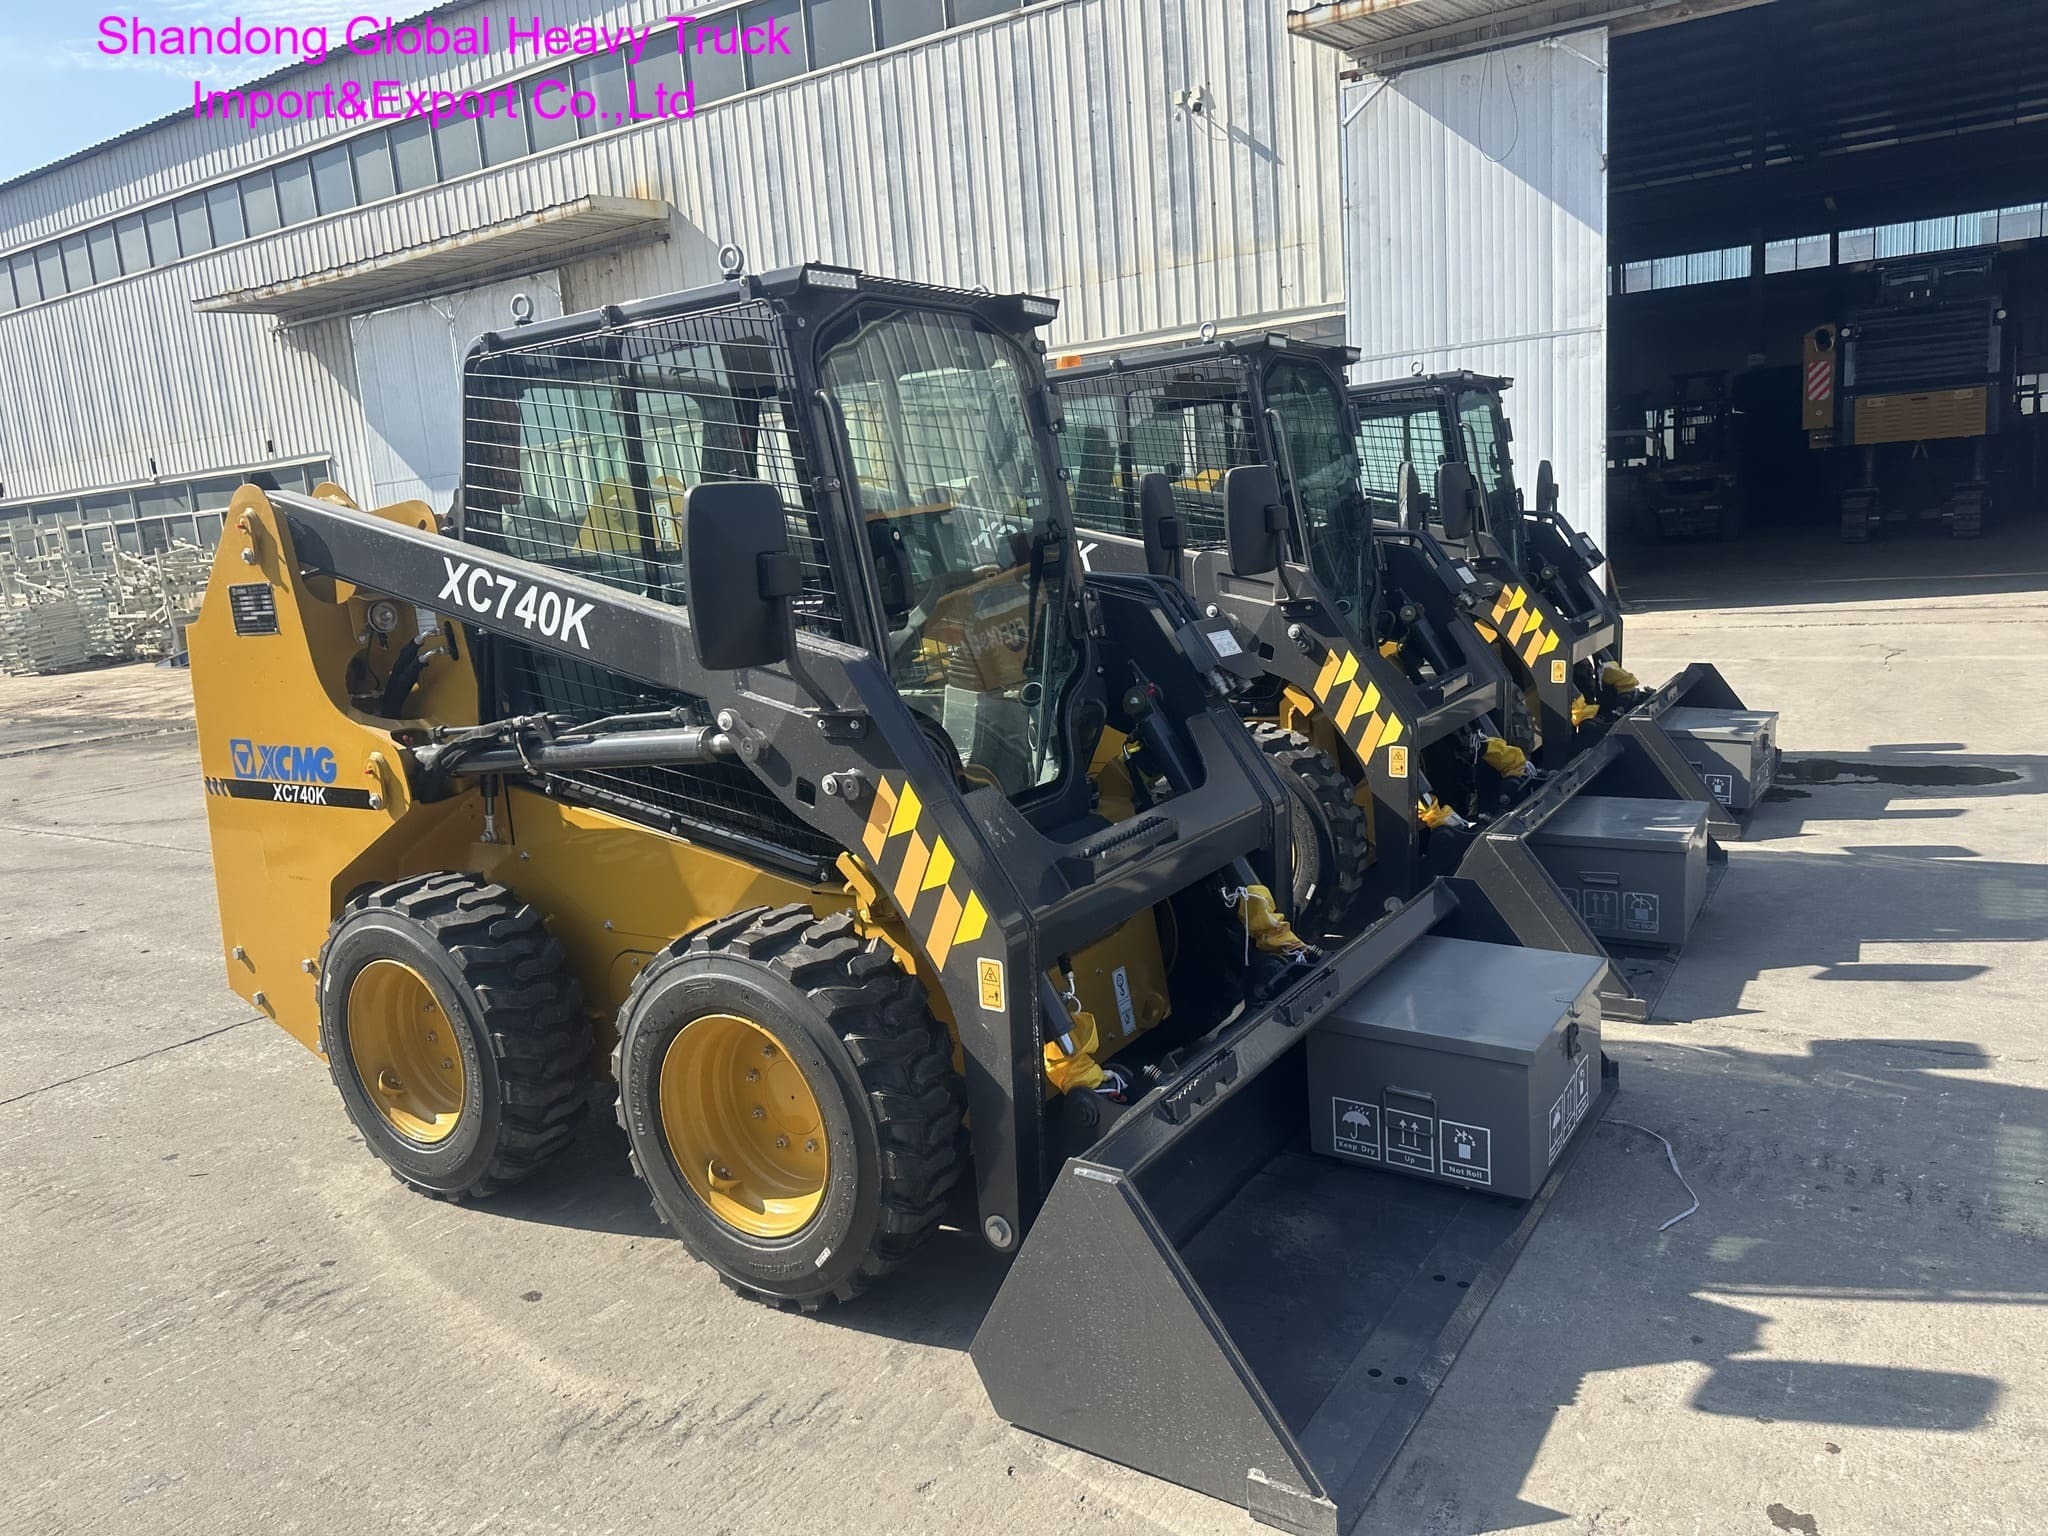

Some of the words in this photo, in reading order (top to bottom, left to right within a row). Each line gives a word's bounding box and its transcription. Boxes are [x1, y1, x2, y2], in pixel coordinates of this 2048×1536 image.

[438, 556, 596, 650] XC740K
[256, 745, 336, 784] XCMG
[272, 783, 328, 806] XC740K
[1338, 1140, 1357, 1151] Keep
[1361, 1144, 1376, 1156] Dry
[1404, 1154, 1416, 1164] Up
[1449, 1166, 1464, 1176] Not
[1466, 1169, 1482, 1179] Roll
